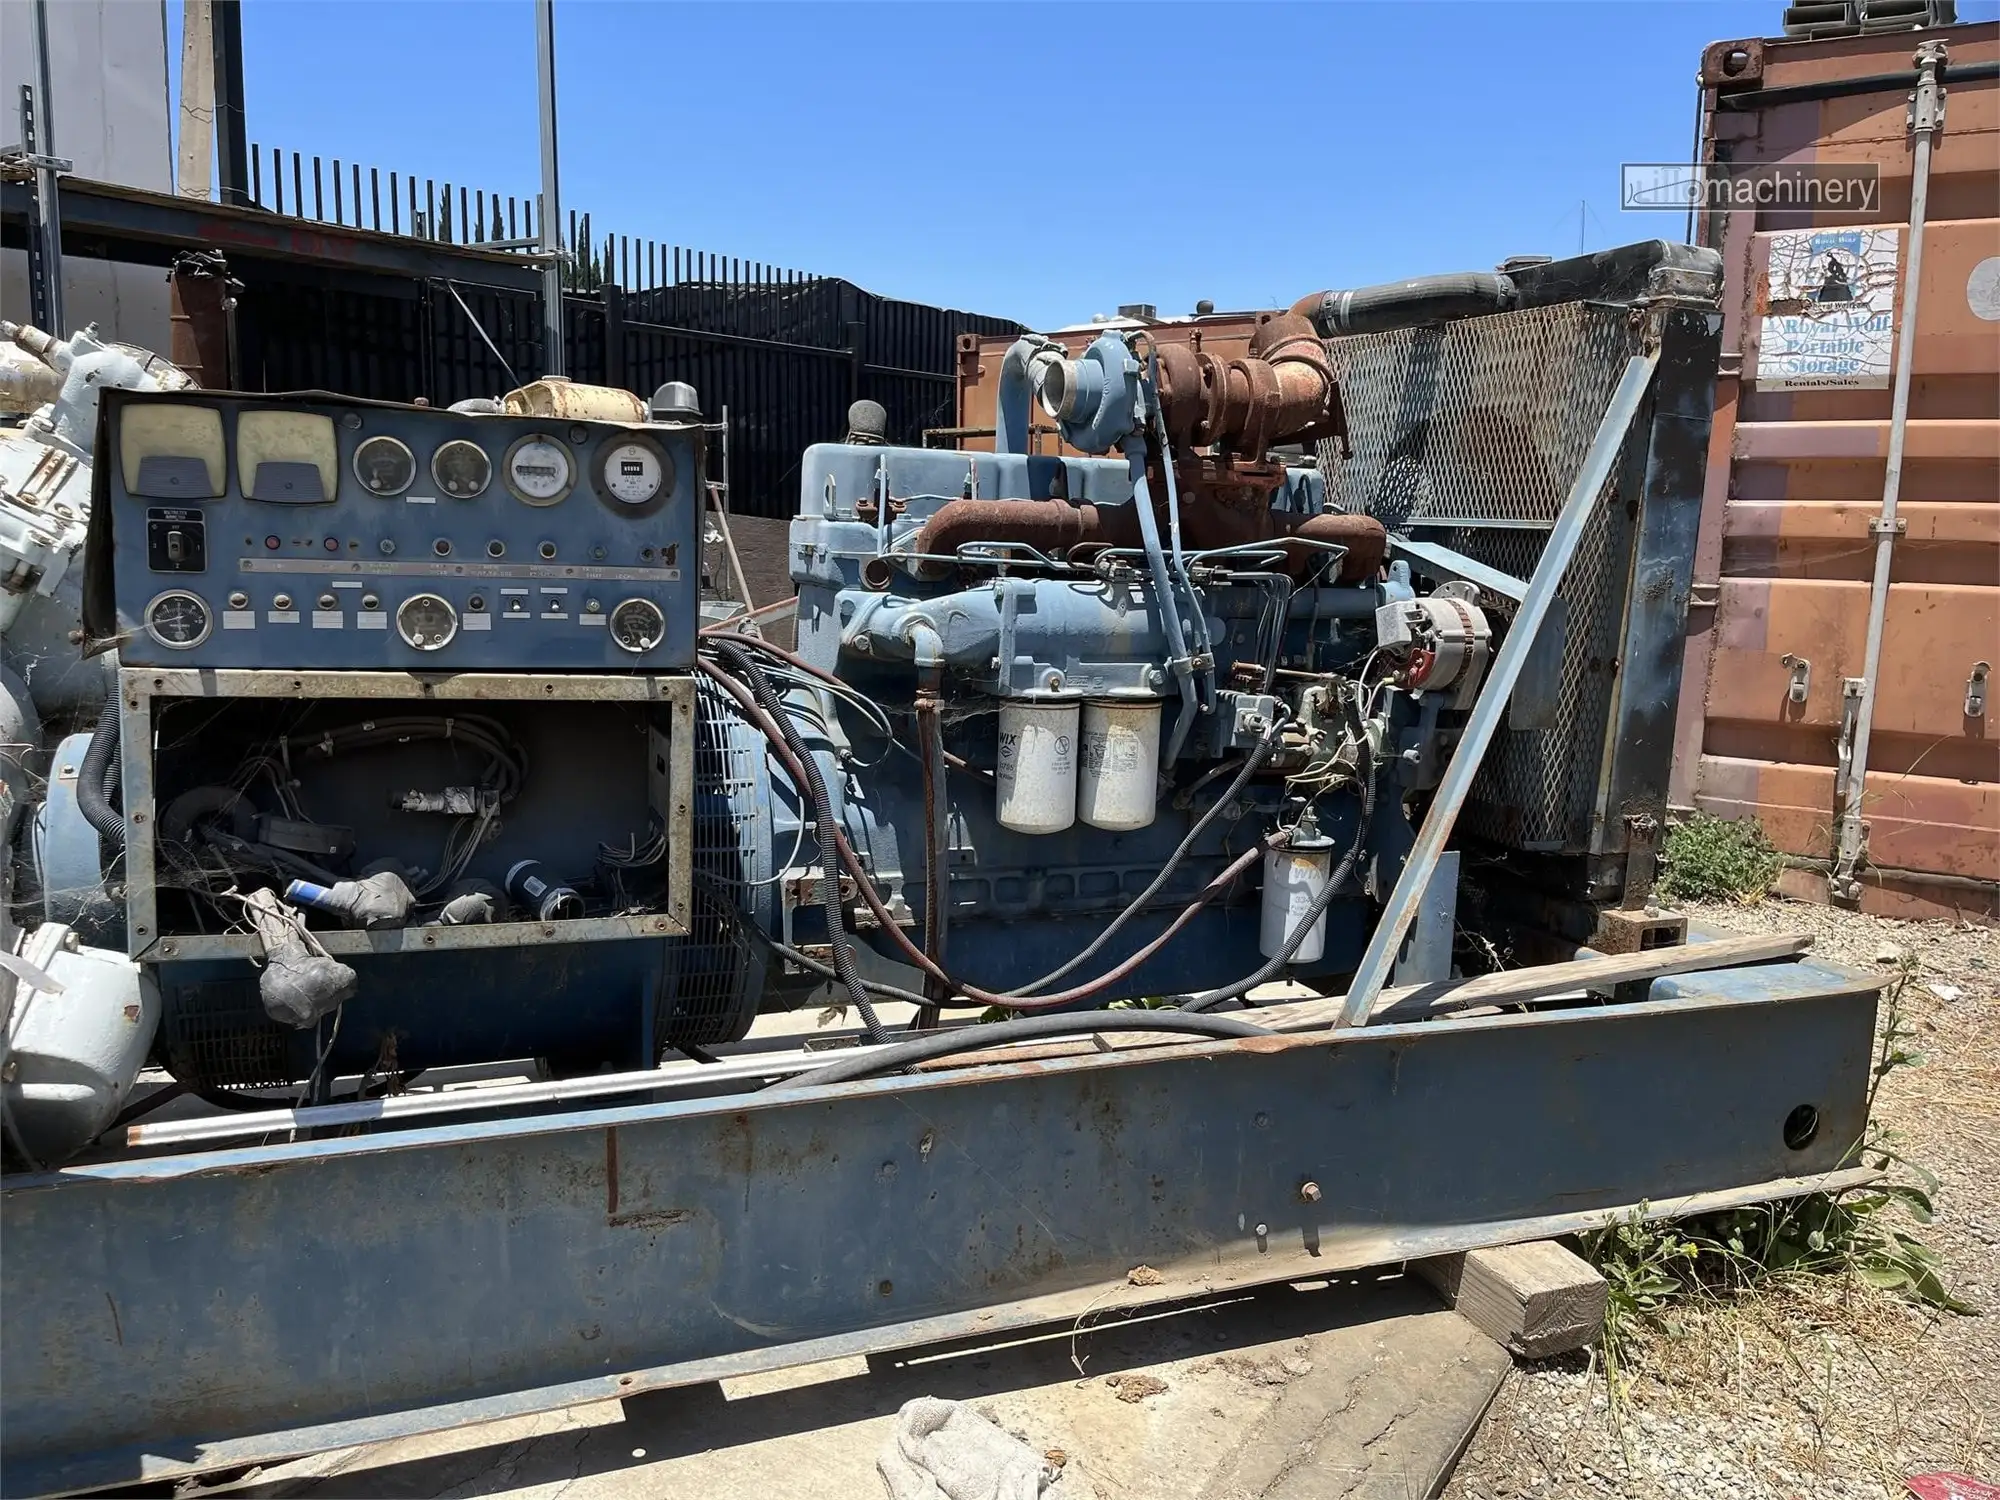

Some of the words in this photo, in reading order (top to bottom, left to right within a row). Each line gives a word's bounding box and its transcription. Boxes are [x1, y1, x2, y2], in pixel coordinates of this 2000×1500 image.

[1784, 318, 1838, 336] Royal
[1846, 315, 1891, 332] Wolf
[1786, 339, 1864, 354] Portable
[1787, 358, 1860, 375] Storage
[1784, 379, 1860, 388] Rentals/Sales
[1000, 732, 1017, 746] WIX
